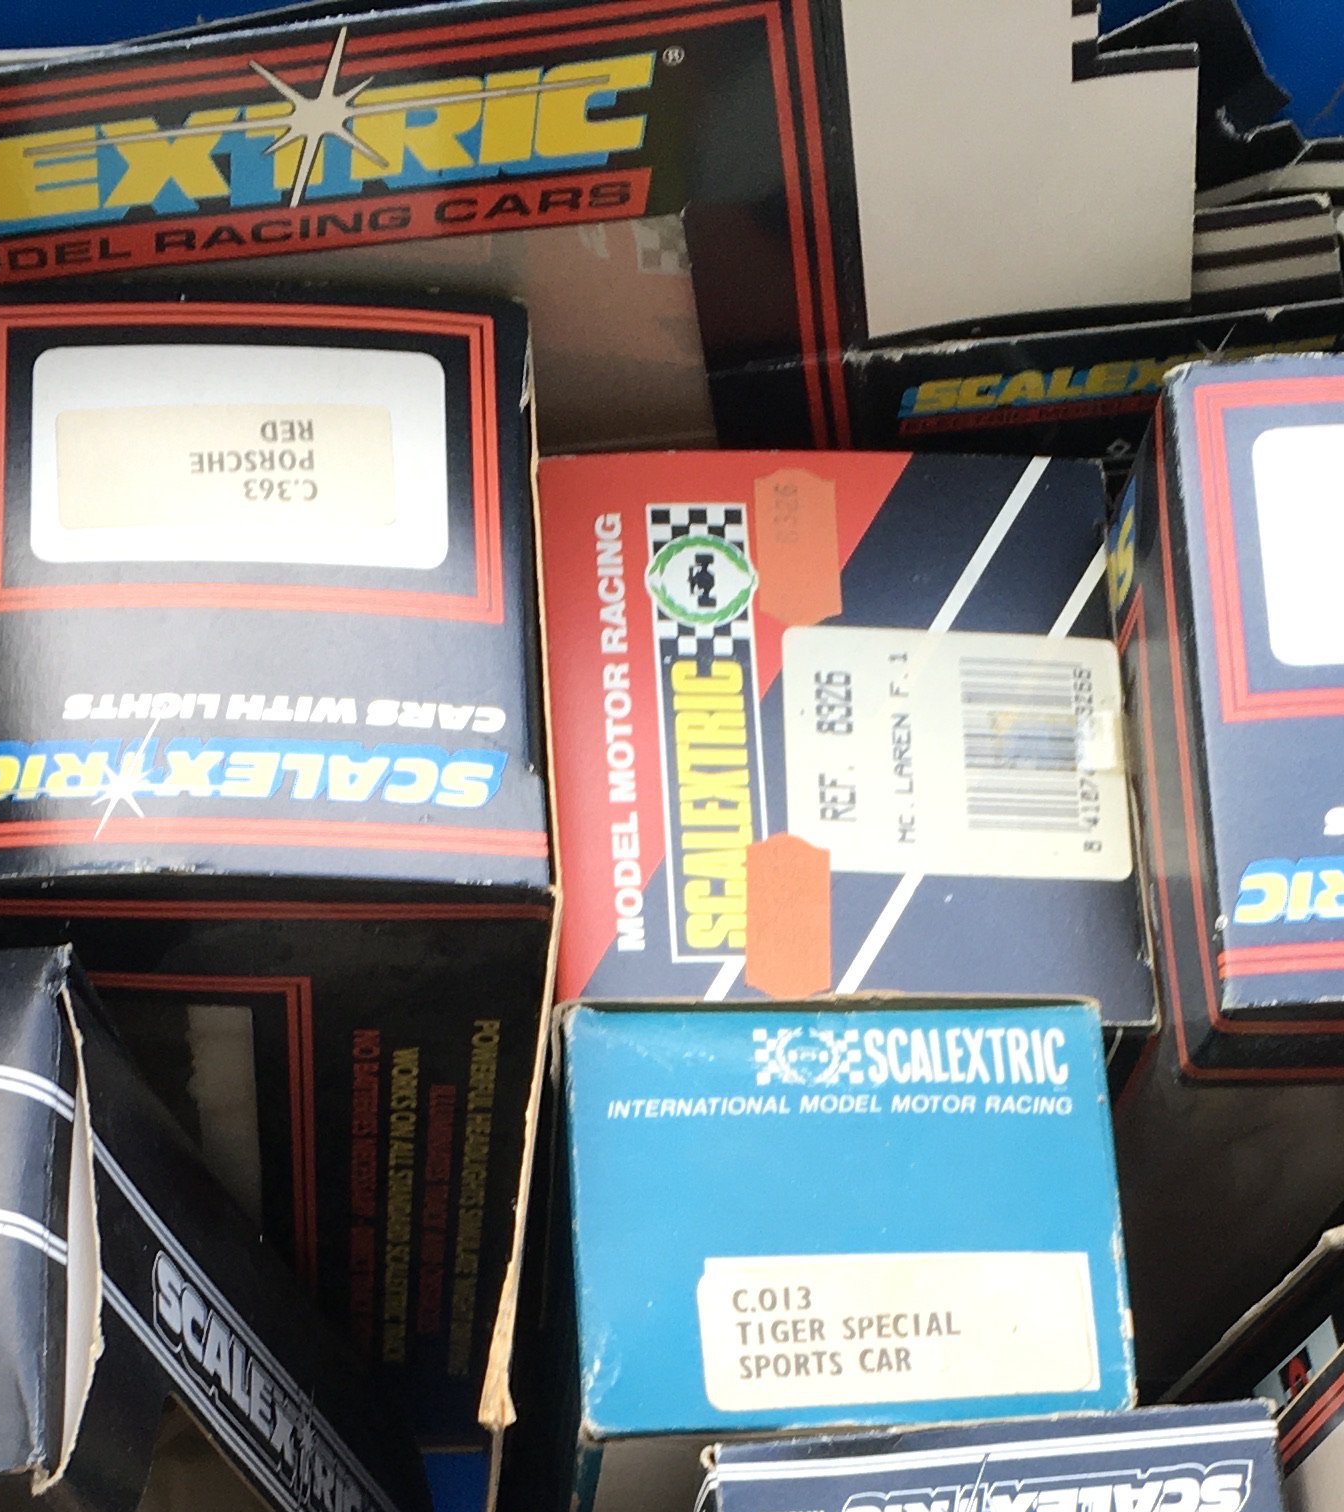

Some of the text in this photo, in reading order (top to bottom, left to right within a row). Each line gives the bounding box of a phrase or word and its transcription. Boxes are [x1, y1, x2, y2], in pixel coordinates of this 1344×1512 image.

[156, 204, 413, 257] RACING
[434, 181, 632, 225] CARS
[261, 420, 314, 442] RED
[190, 451, 314, 474] PORSCHE
[244, 479, 318, 500] C.363
[64, 692, 506, 732] CARS WITH LIGHTS
[595, 512, 645, 951] MODEL MOTOR RACING
[814, 670, 856, 823] REF. 8326
[891, 714, 914, 792] LAREN
[670, 660, 748, 949] SCALEXTRIC
[864, 1027, 1069, 1086] SCALEXTRIC
[606, 1094, 1073, 1120] INTERNATIONAL MODEL MOTOR RACING
[736, 1312, 962, 1346] TIGER SPECIAL
[739, 1348, 912, 1380] SPORTS CAR
